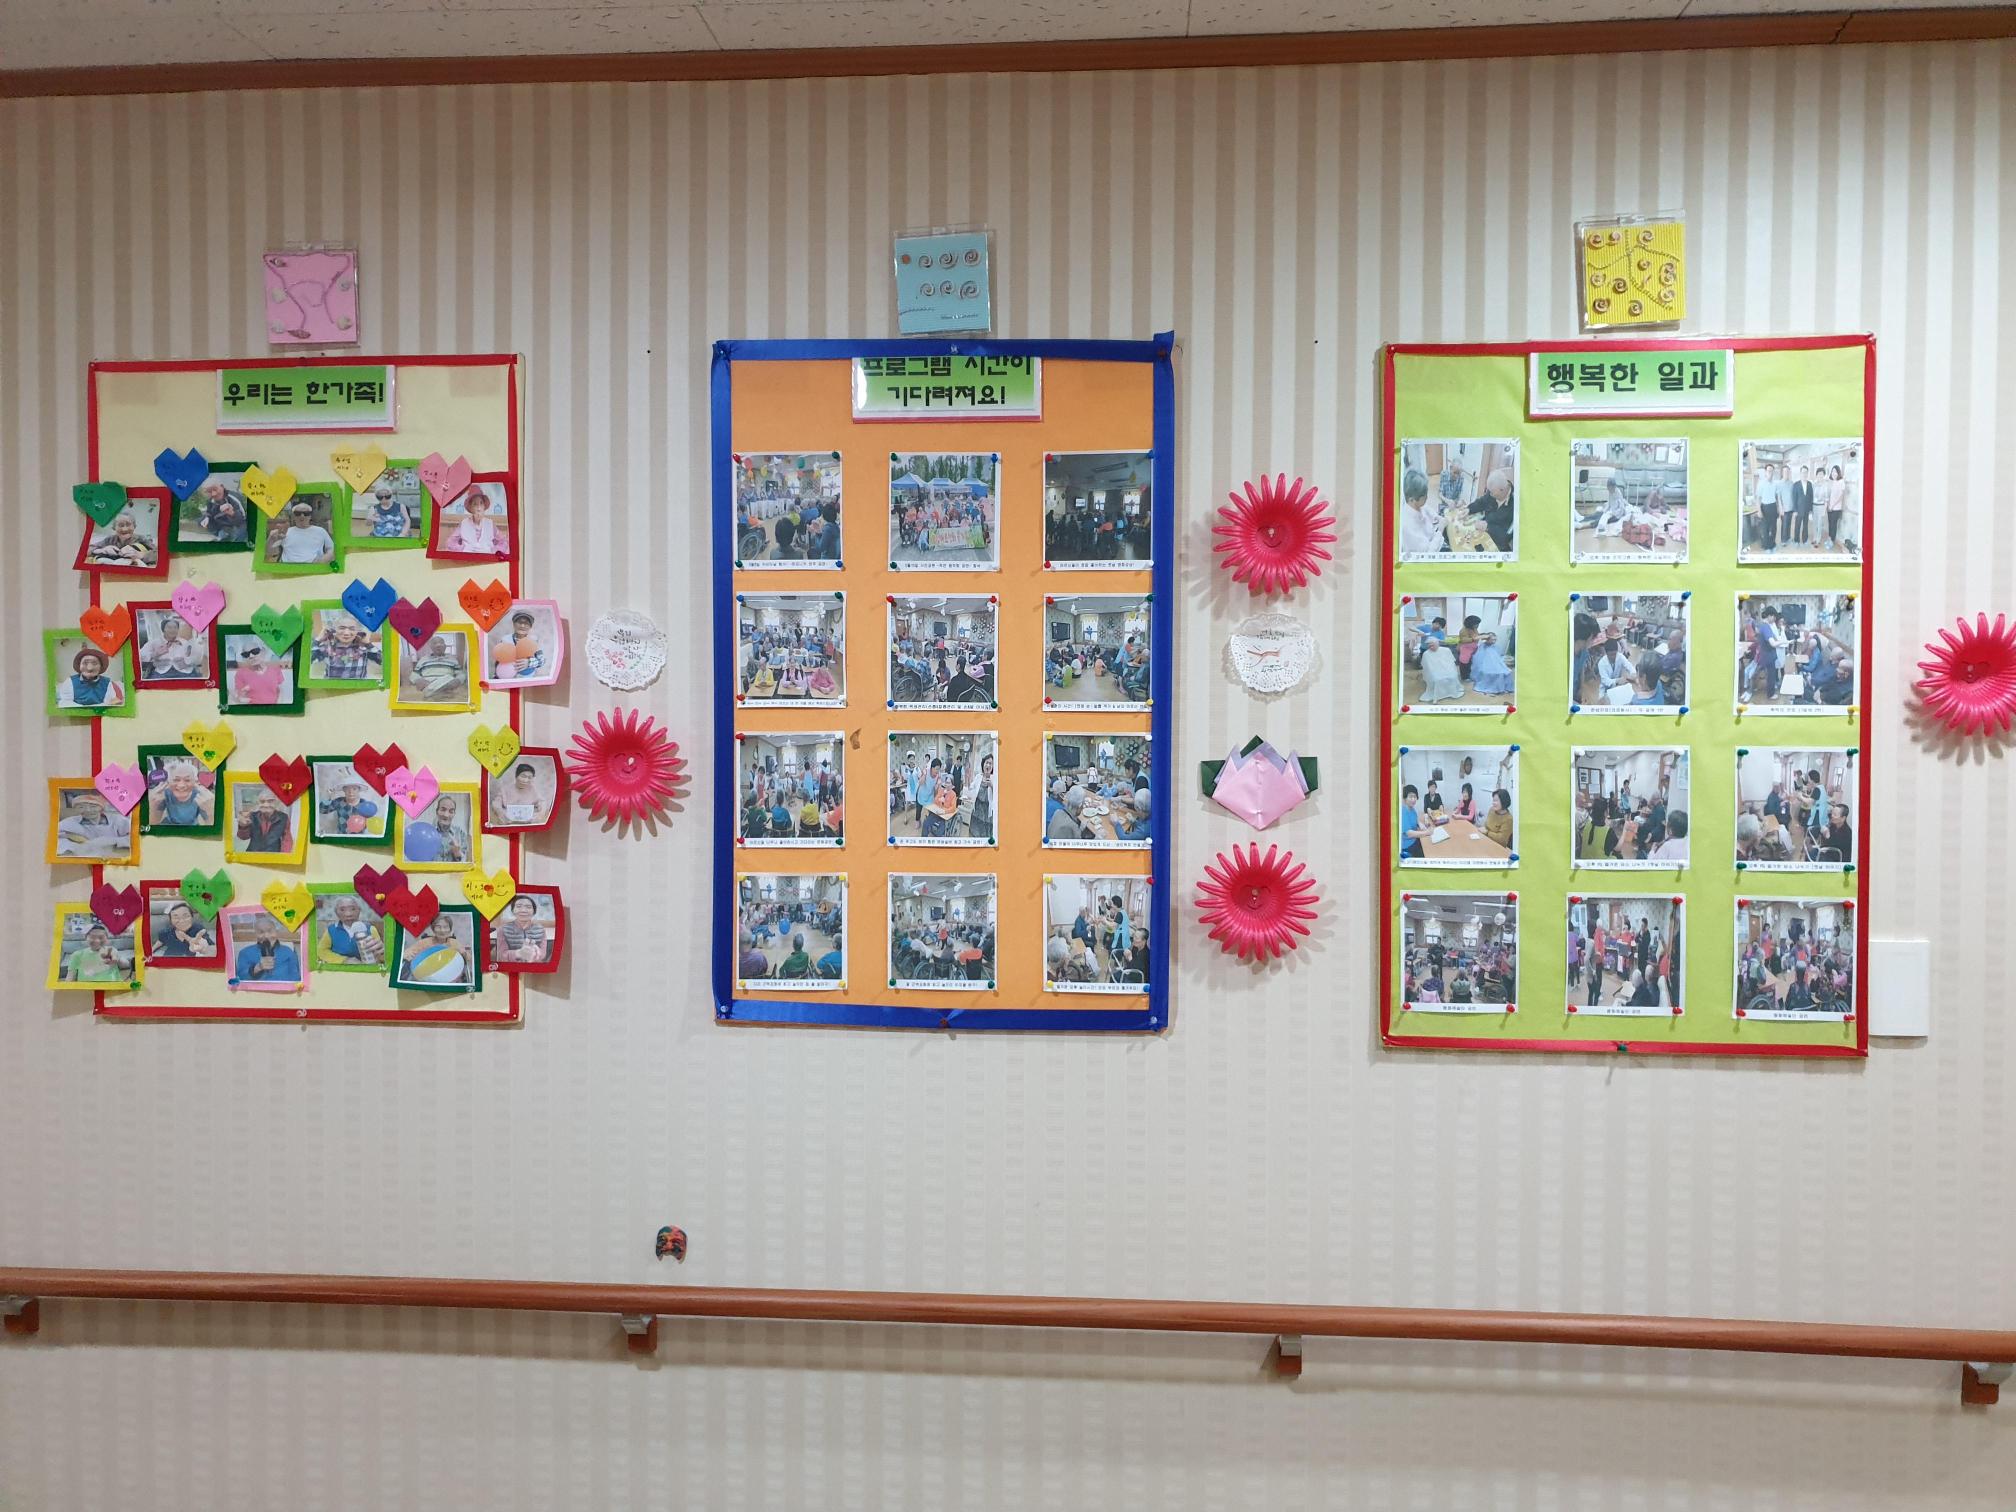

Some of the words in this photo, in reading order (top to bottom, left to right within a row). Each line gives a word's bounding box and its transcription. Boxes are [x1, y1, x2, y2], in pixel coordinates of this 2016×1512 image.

[863, 356, 951, 376] 프로그램
[1547, 362, 1639, 393] 행복한
[1657, 361, 1719, 392] 일과
[223, 383, 293, 406] 우리는
[306, 381, 384, 405] 한가족!
[887, 385, 1006, 407] 기다려져요!
